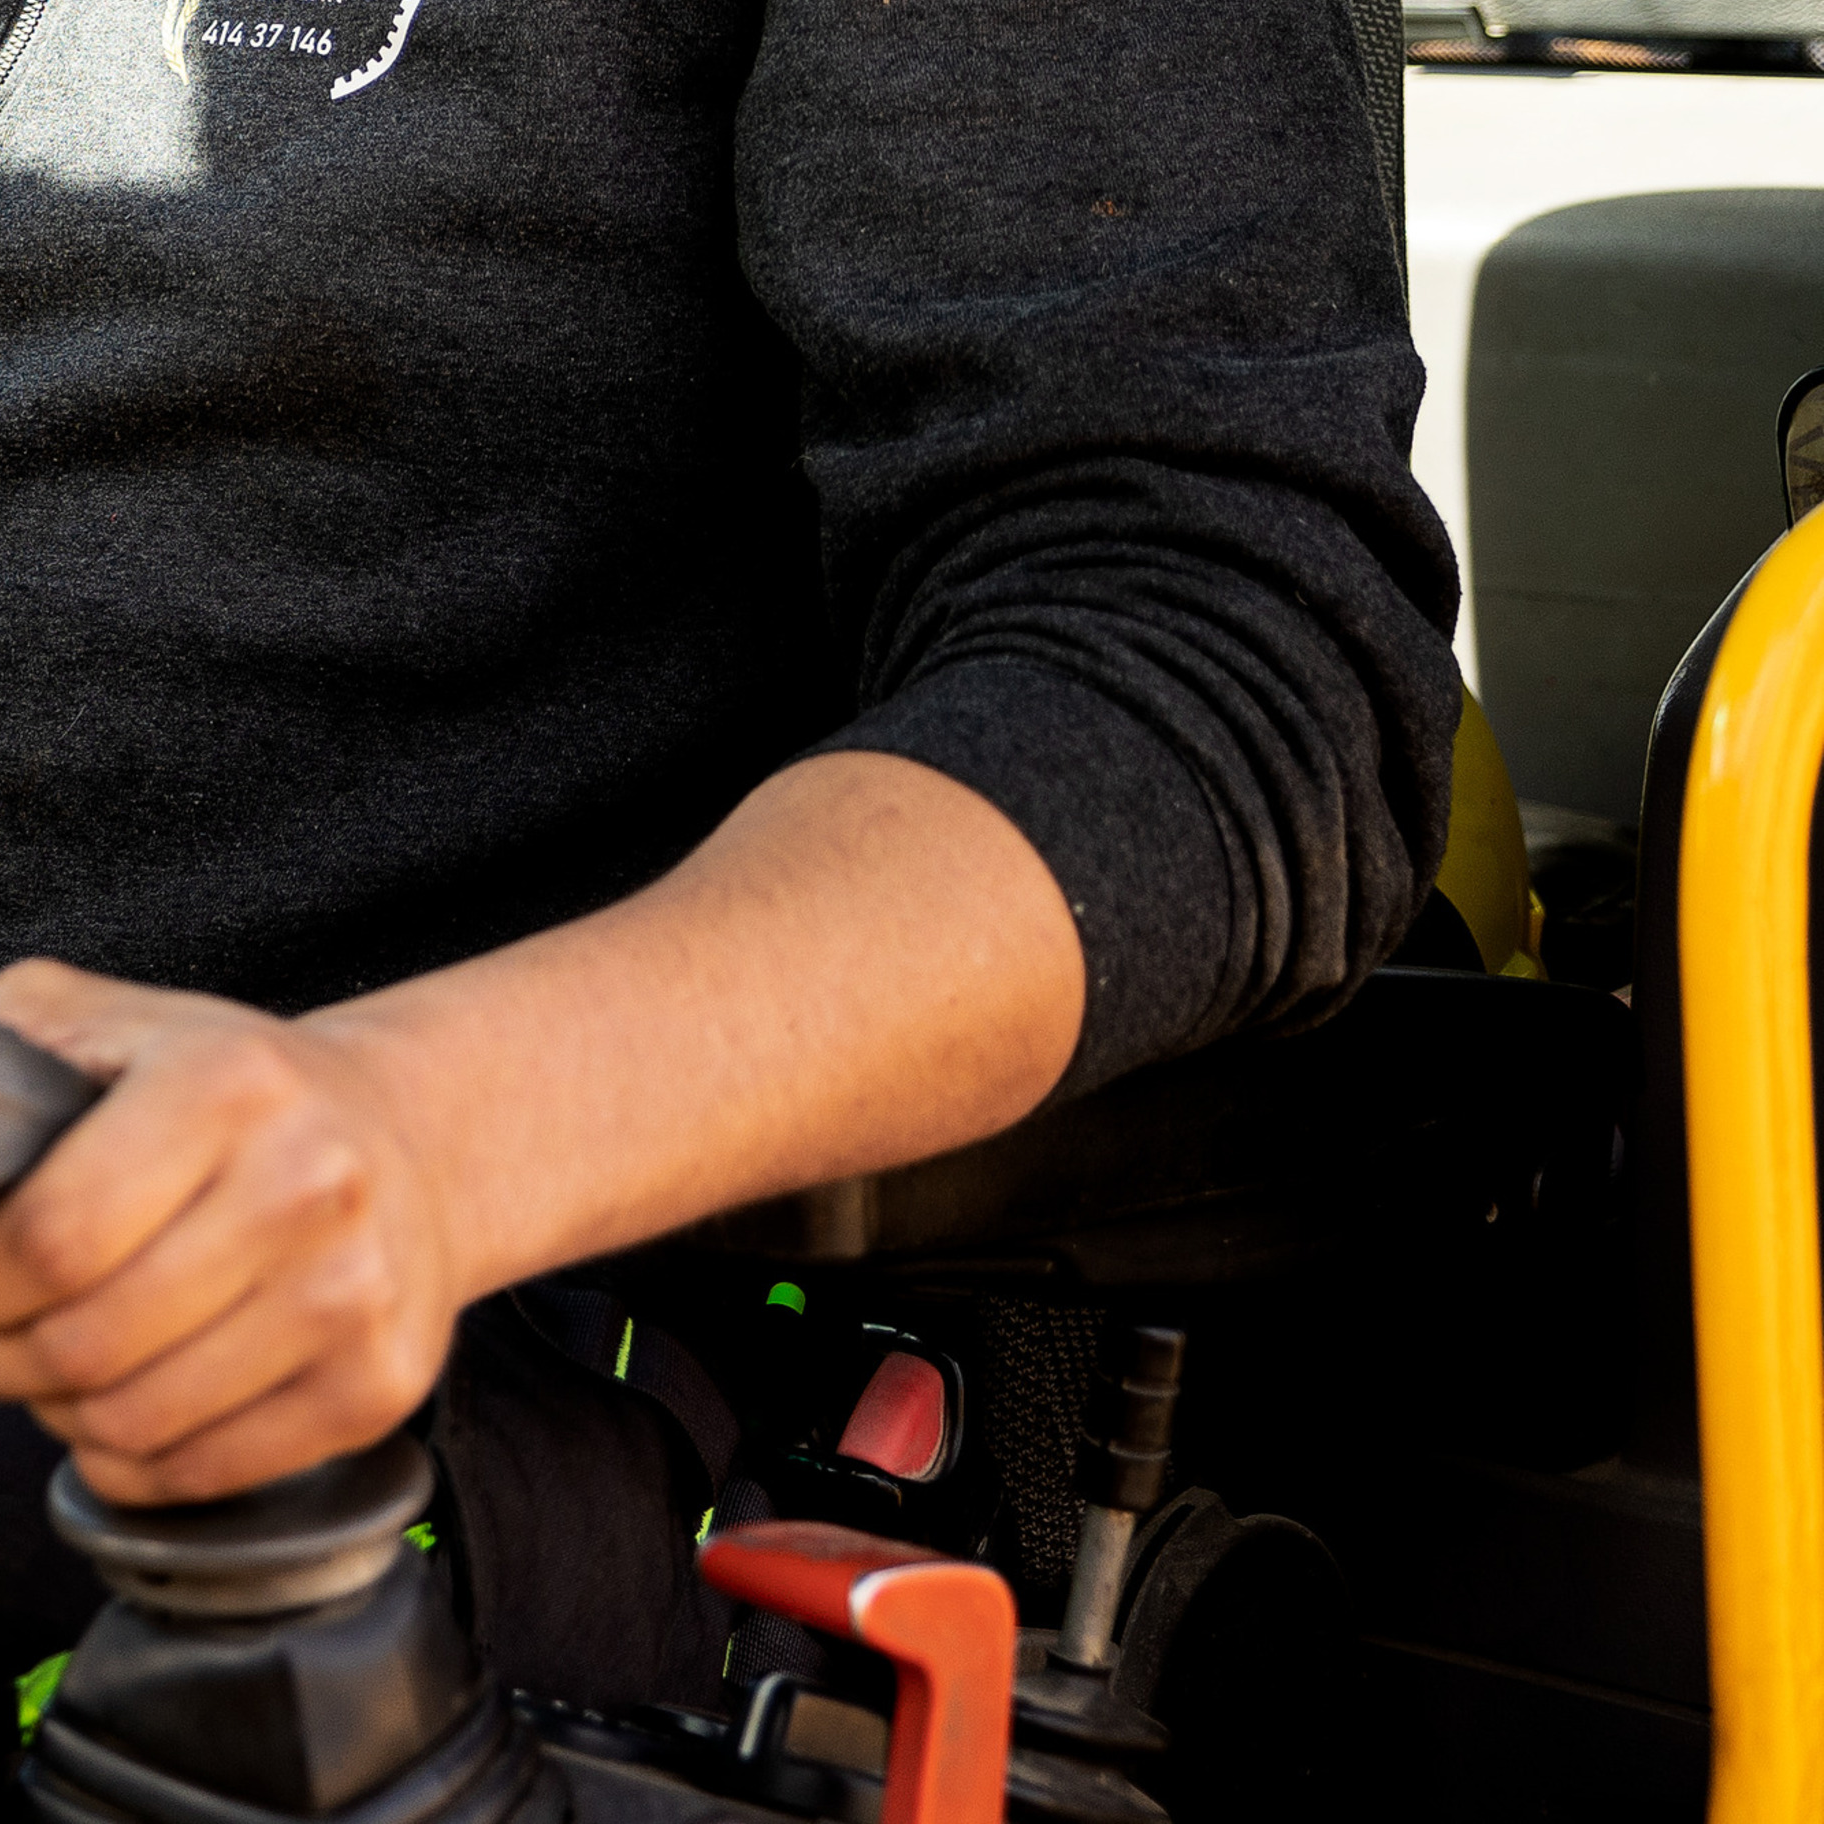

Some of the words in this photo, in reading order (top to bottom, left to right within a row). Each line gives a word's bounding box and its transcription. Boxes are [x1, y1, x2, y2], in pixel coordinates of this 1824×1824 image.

[201, 20, 244, 47] 414
[250, 23, 284, 48] 37
[289, 25, 332, 55] 146
